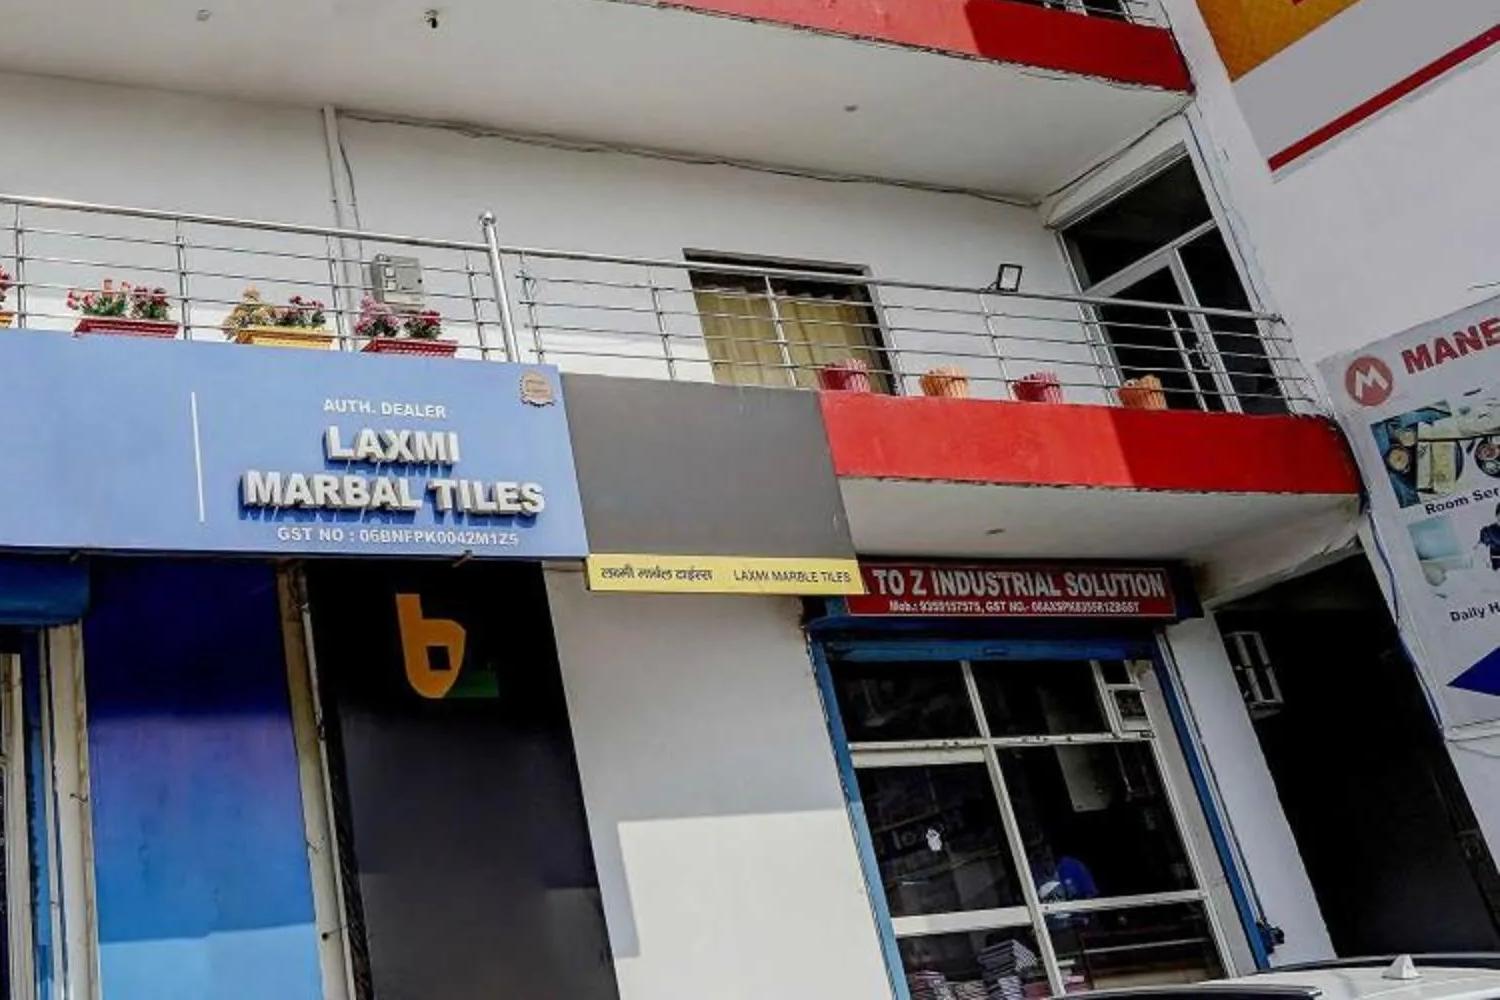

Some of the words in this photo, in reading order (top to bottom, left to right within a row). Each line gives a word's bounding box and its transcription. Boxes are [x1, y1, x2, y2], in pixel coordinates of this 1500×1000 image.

[323, 398, 376, 417] AUTH.
[380, 401, 447, 420] DEALER
[324, 424, 461, 464] LAXMI
[241, 469, 423, 511] MARBAL
[428, 478, 546, 517] TILES
[1424, 496, 1469, 516] Room
[276, 526, 313, 543] GST
[318, 527, 345, 543] NO
[733, 569, 769, 582] LAXMI
[771, 570, 819, 584] MARBLE
[820, 571, 852, 584] TILES
[871, 568, 906, 596] TO
[909, 570, 928, 597] Z
[929, 569, 1063, 598] INDUSTRIAL
[1063, 571, 1166, 598] SOLUTION
[985, 601, 1007, 613] GST
[1449, 606, 1486, 623] Daily
